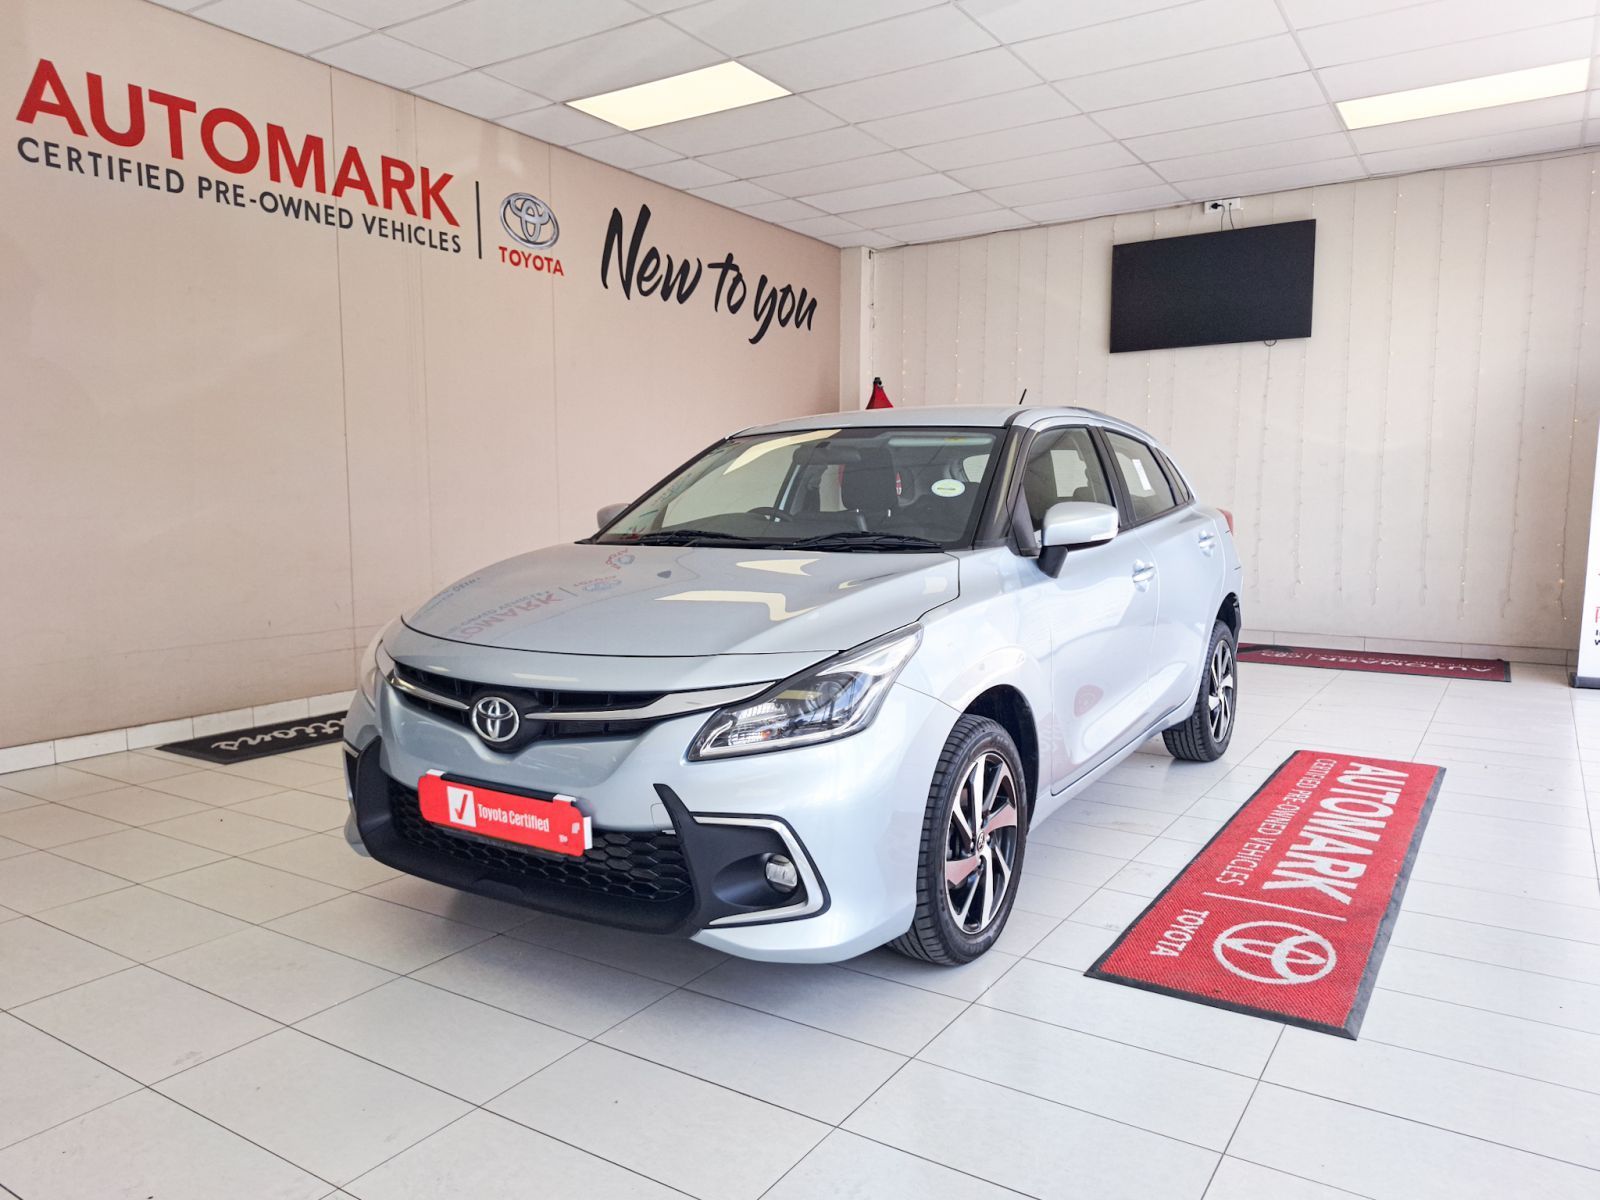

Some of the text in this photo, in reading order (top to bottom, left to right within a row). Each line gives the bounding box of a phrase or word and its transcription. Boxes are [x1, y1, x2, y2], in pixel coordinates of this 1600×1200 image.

[16, 59, 460, 228] AUTOMARK
[17, 136, 462, 254] CERTIFIED PRE-OWNED VEHICLES
[498, 245, 565, 276] TOYOTA
[601, 204, 818, 345] New to you
[210, 717, 345, 751] tions
[477, 803, 550, 833] Toyota Certified
[1214, 757, 1338, 887] CERTIFIED PRE-OWNED VEHICLES
[1261, 761, 1409, 906] AUTOMARK
[1149, 908, 1210, 957] TOYOTA
